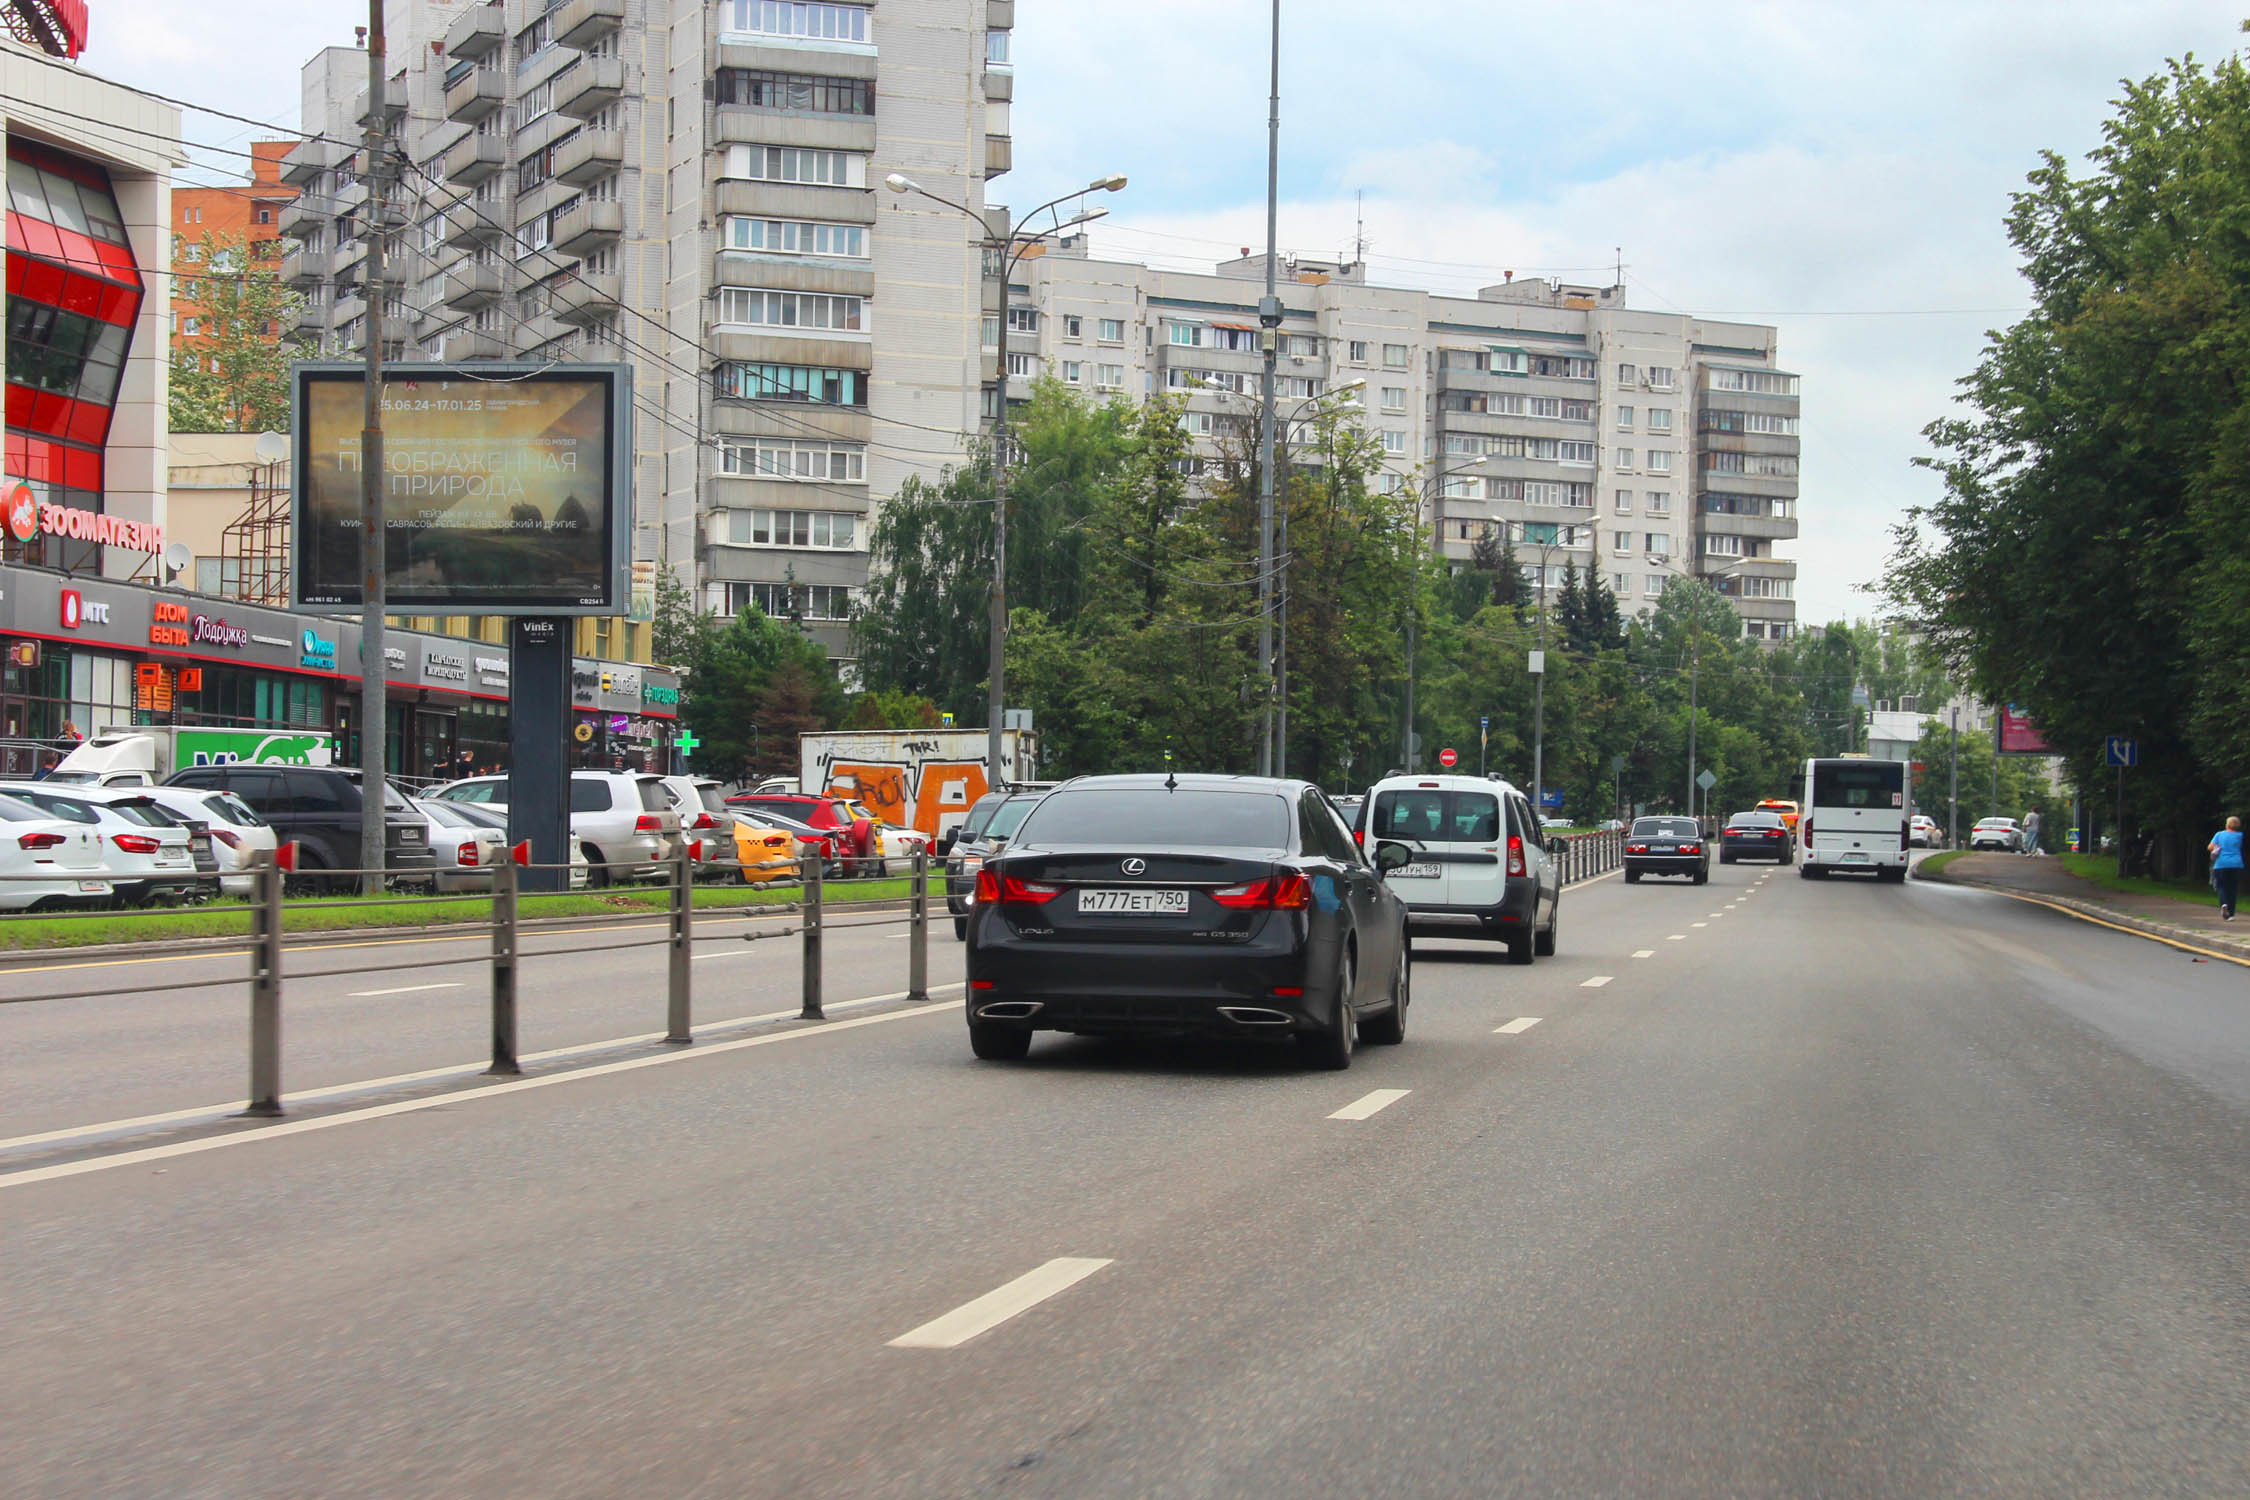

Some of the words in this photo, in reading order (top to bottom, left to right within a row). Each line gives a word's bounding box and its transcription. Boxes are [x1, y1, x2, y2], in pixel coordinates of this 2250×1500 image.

[338, 451, 577, 473] ПОБРАЖЕННАЯ
[391, 474, 525, 500] ПРИРОДА
[39, 502, 163, 555] ЗООМАГАЗИН
[544, 520, 577, 531] ДРУГИЕ
[81, 600, 110, 624] МТС
[154, 602, 189, 622] ДОМ
[150, 625, 190, 647] БЫТА
[193, 614, 247, 648] Подружка
[523, 621, 554, 631] VinEx
[1082, 892, 1153, 910] М777ЕТ
[1157, 891, 1184, 905] 750
